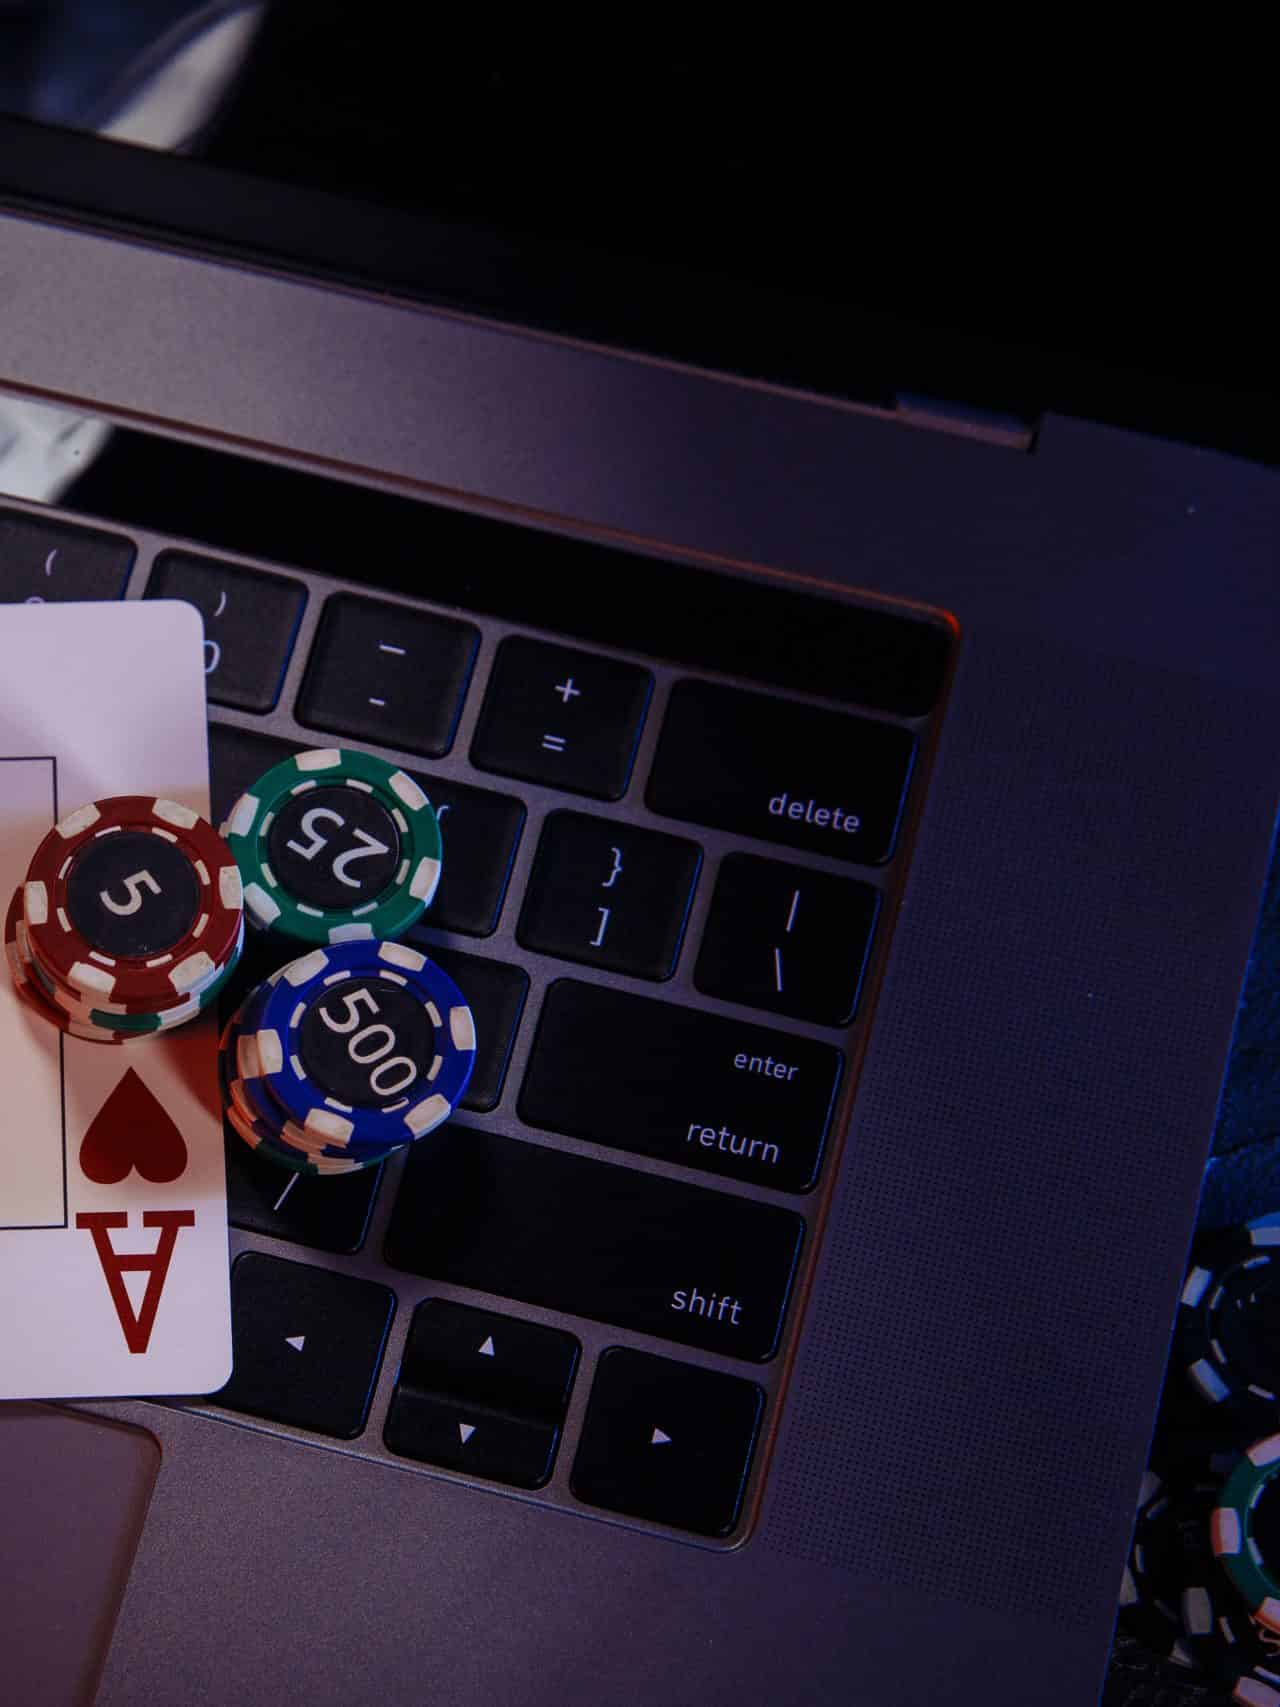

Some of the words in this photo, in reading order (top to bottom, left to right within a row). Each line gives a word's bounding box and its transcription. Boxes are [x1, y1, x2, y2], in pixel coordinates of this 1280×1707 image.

[555, 678, 580, 702] +
[542, 734, 566, 752] =
[769, 793, 860, 832] delete
[286, 807, 391, 889] 25
[602, 847, 623, 888] }
[100, 869, 162, 916] 5
[590, 907, 611, 947] ]
[320, 988, 417, 1096] 500
[734, 1053, 799, 1081] enter
[687, 1123, 780, 1164] return
[76, 1210, 195, 1353] A
[671, 1287, 742, 1325] shift
